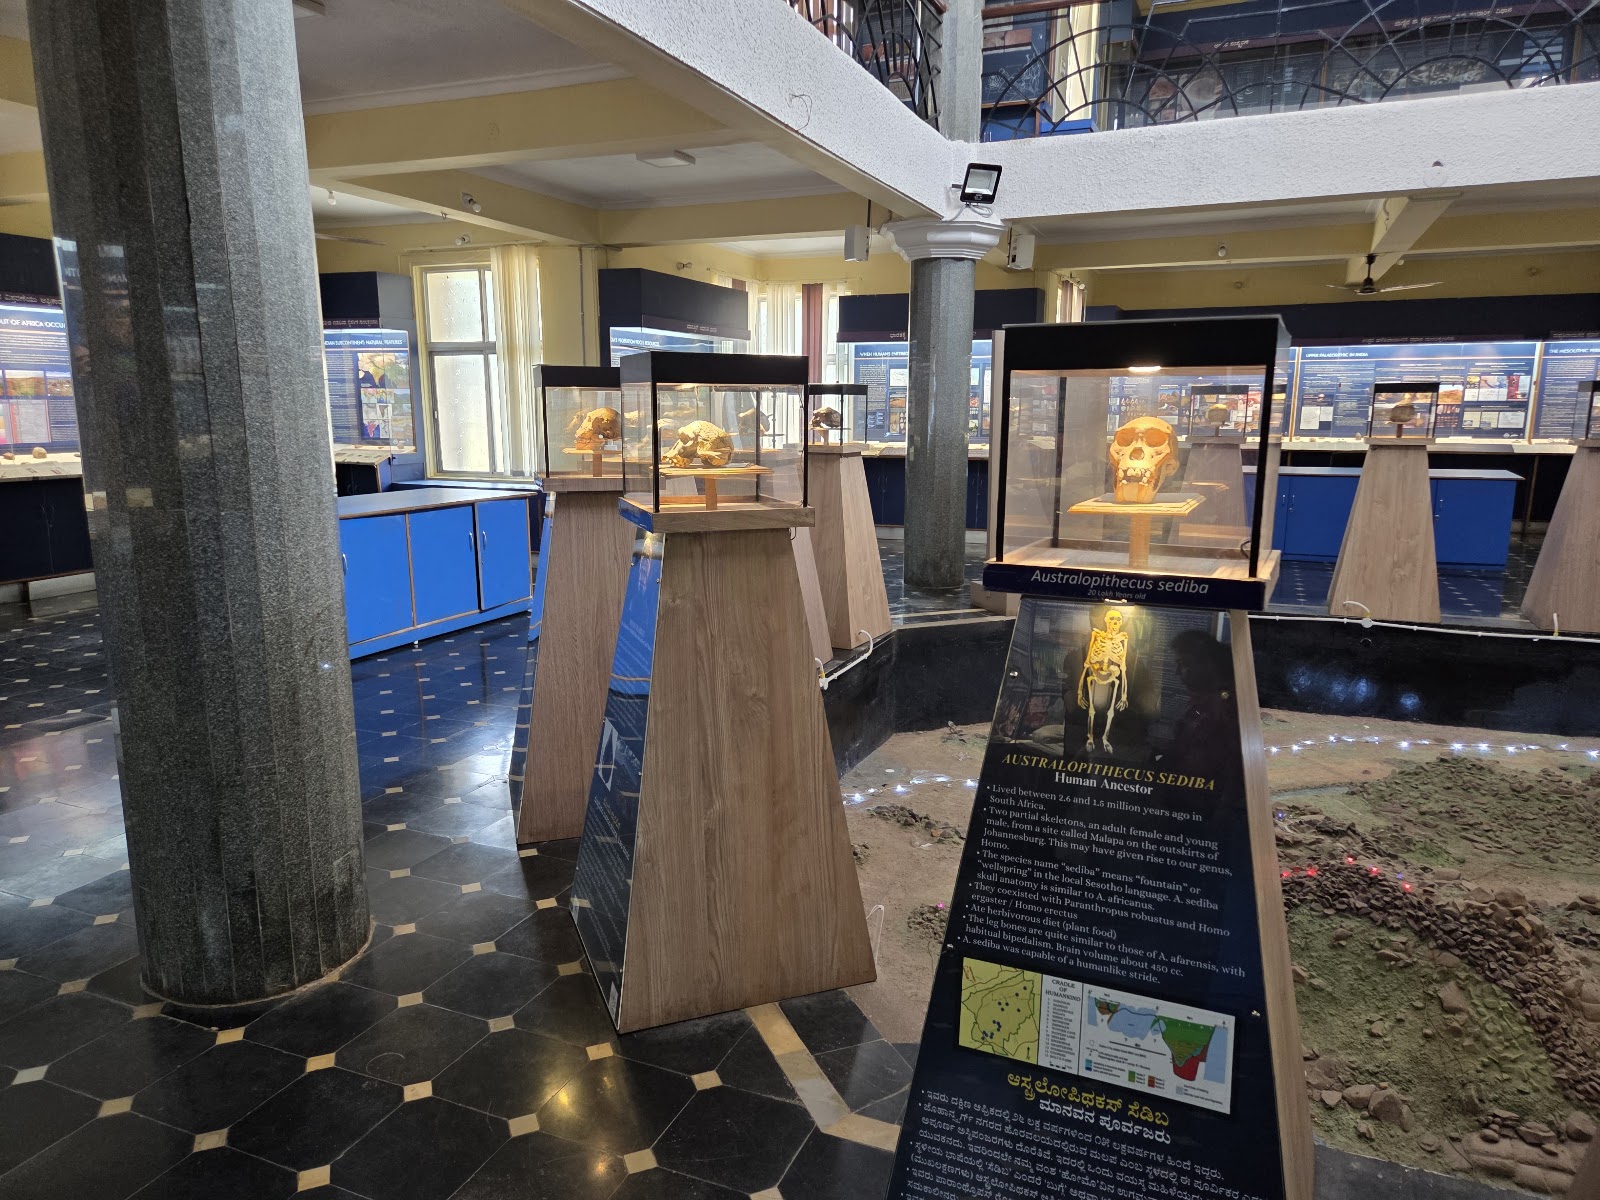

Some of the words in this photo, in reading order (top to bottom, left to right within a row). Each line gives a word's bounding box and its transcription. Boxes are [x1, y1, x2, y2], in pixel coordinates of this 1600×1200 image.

[1031, 570, 1153, 590] Australopithecus
[1157, 577, 1209, 594] sediba
[1098, 590, 1113, 598] Lakh
[1115, 591, 1133, 599] Years
[1002, 753, 1154, 782] AUSTRALOPITHECUS
[1156, 772, 1216, 792] SEDIBA
[1054, 771, 1097, 788] Human
[1100, 778, 1154, 795] Ancestor
[989, 794, 1015, 806] South
[1016, 798, 1046, 811] Africa.
[992, 784, 1017, 795] Lived
[1018, 786, 1056, 801] between
[1072, 796, 1090, 806] and
[1106, 800, 1141, 813] million
[1141, 806, 1170, 817] years
[1171, 811, 1190, 821] ago
[1192, 813, 1202, 822] in
[980, 838, 1010, 850] Homo.
[986, 817, 1010, 828] male,
[1011, 820, 1033, 831] from
[1042, 825, 1059, 835] site
[1060, 828, 1088, 840] called
[1089, 832, 1124, 846] Malapa
[1126, 840, 1139, 848] on
[1141, 840, 1158, 851] the
[1159, 845, 1205, 858] outskirts
[1206, 851, 1220, 861] of
[988, 805, 1008, 816] Two
[1009, 810, 1039, 821] partial
[1040, 812, 1086, 829] skeletons,
[1087, 822, 1100, 830] an
[1101, 823, 1127, 835] adult
[1129, 826, 1163, 840] female
[1163, 833, 1184, 843] and
[1184, 837, 1218, 850] young
[983, 827, 1046, 847] Johannesburg.
[1048, 837, 1069, 848] This
[1070, 842, 1090, 854] may
[1092, 843, 1115, 856] have
[1116, 848, 1144, 861] given
[1146, 853, 1165, 864] rise
[1166, 857, 1177, 866] to
[1178, 860, 1198, 870] our
[1198, 864, 1233, 876] genus,
[976, 870, 998, 882] skull
[999, 876, 1039, 891] anatomy
[1040, 881, 1048, 891] is
[1049, 884, 1083, 897] similar
[1084, 890, 1095, 899] to
[1095, 892, 1106, 902] A.
[1107, 894, 1155, 911] africanus.
[981, 849, 999, 860] The
[999, 854, 1032, 865] species
[1033, 859, 1059, 870] name
[1101, 871, 1133, 883] means
[1189, 886, 1201, 895] or
[1033, 868, 1042, 878] in
[1044, 871, 1060, 882] the
[1061, 873, 1083, 886] local
[1084, 878, 1123, 893] Sesotho
[1124, 884, 1171, 902] language.
[1172, 894, 1184, 904] A.
[1185, 897, 1218, 910] sediba
[970, 903, 986, 913] Ate
[987, 905, 1041, 924] herbivorous
[1042, 916, 1060, 928] diet
[1062, 920, 1090, 934] (plant
[1091, 925, 1117, 940] food)
[971, 893, 1008, 906] ergaster
[1014, 900, 1042, 913] Homo
[1043, 907, 1078, 920] erectus
[973, 881, 996, 894] They
[996, 887, 1039, 901] coexisted
[1041, 894, 1062, 905] with
[1063, 897, 1129, 917] Paranthropus
[1130, 911, 1175, 926] robustus
[1176, 920, 1196, 931] and
[1198, 922, 1230, 936] Homo
[962, 934, 971, 944] A.
[972, 938, 1001, 950] sediba
[1002, 944, 1020, 954] was
[1020, 948, 1056, 962] capable
[1058, 956, 1068, 964] of
[1076, 958, 1127, 977] humanlike
[1128, 972, 1160, 984] stride.
[965, 923, 1001, 939] habitual
[1002, 930, 1054, 950] bipedalism.
[1055, 942, 1081, 955] Brain
[1082, 949, 1119, 963] volume
[1120, 956, 1148, 970] about
[1150, 963, 1168, 973] 450
[1170, 968, 1184, 977] cc.
[967, 913, 984, 924] The
[985, 916, 999, 929] leg
[1000, 919, 1027, 932] bones
[1028, 927, 1043, 936] are
[1044, 930, 1069, 941] quite
[1070, 934, 1104, 948] similar
[1105, 941, 1116, 950] to
[1117, 943, 1145, 956] those
[1146, 950, 1157, 959] of
[1158, 952, 1168, 962] A.
[1170, 954, 1219, 972] afarensis,
[1221, 966, 1246, 978] with
[1045, 990, 1081, 1002] HUMANKIND
